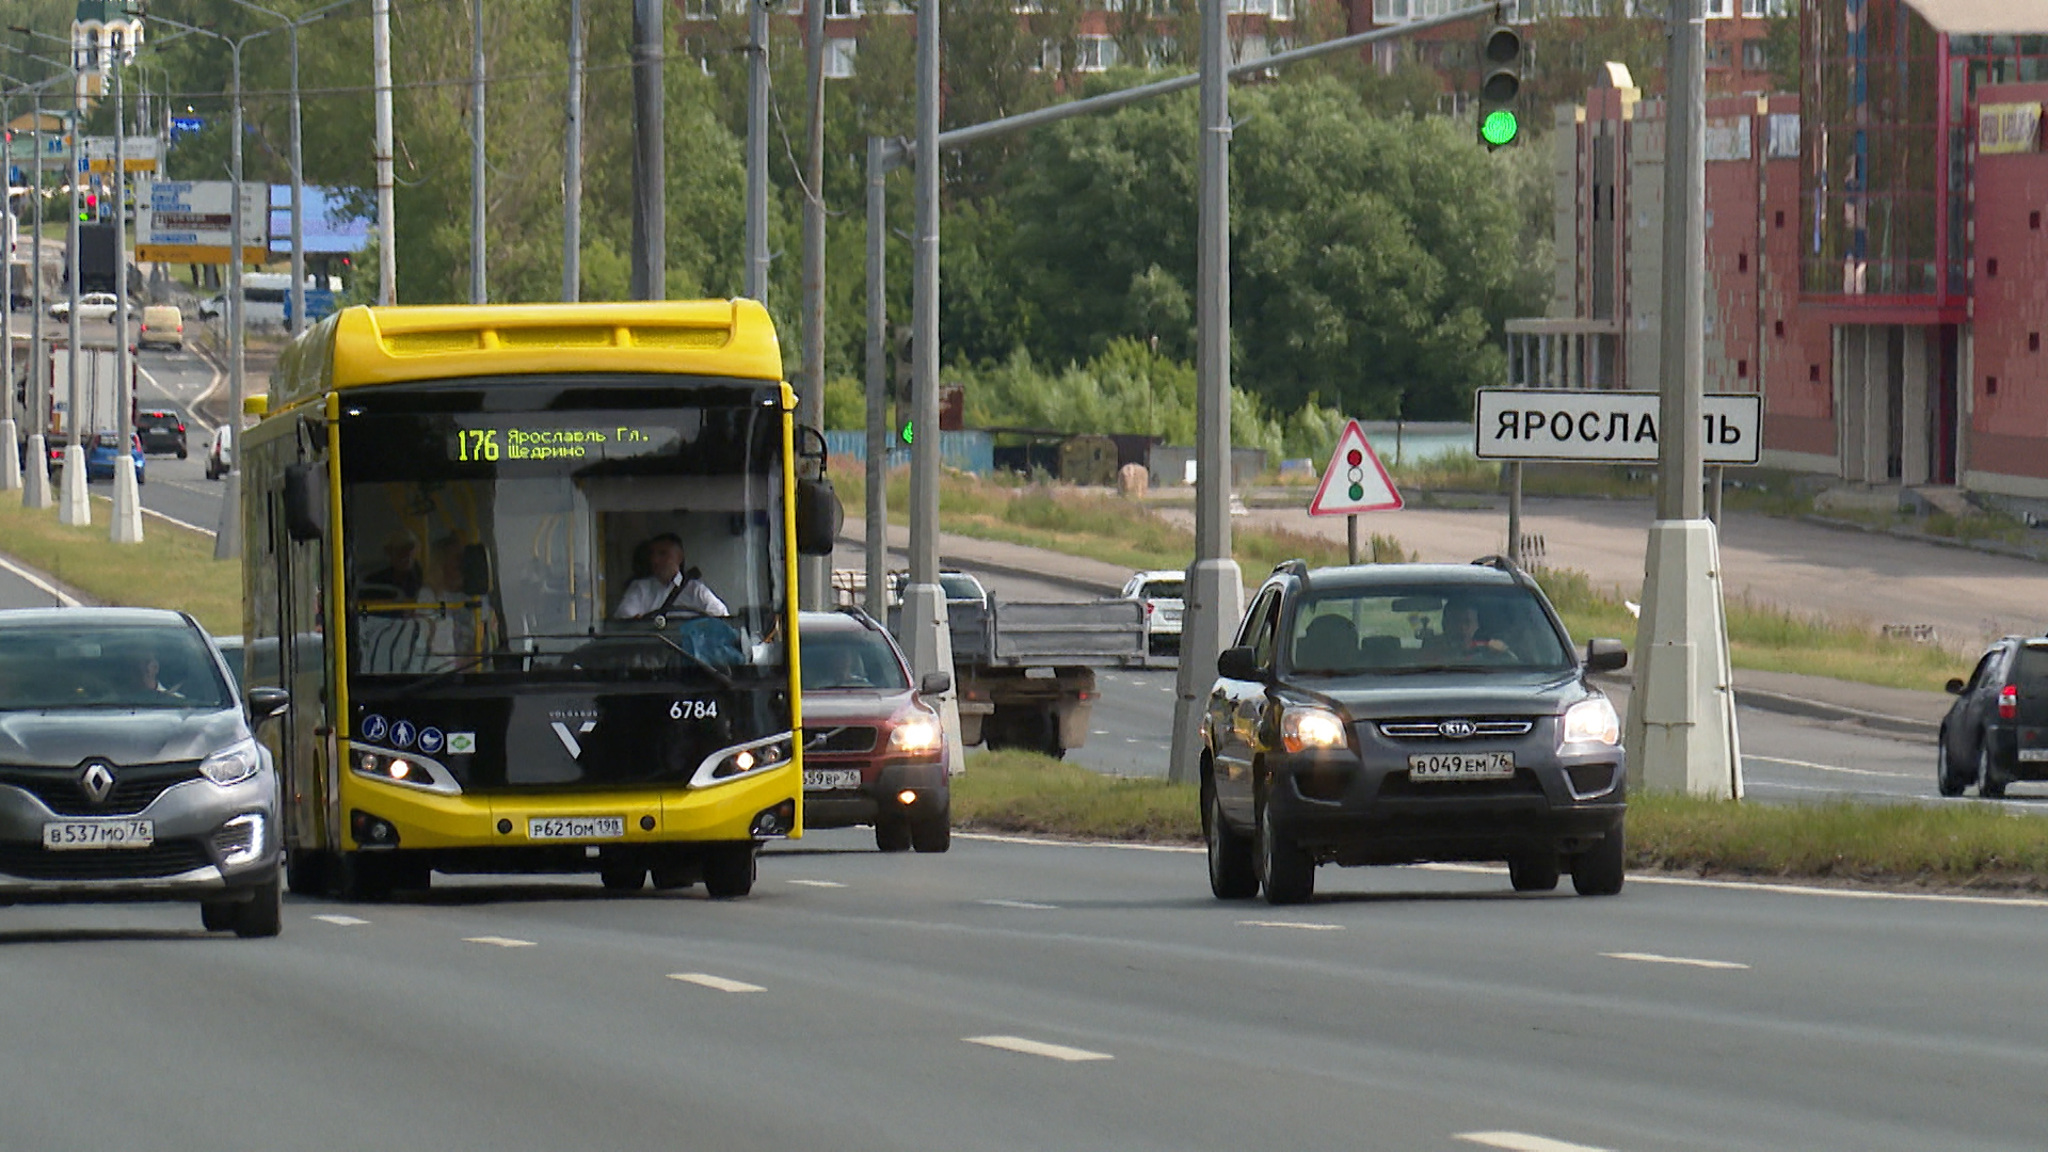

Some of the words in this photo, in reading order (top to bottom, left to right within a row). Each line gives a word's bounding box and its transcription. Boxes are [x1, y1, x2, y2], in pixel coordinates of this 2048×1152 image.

[508, 428, 606, 444] Ярославль
[617, 427, 649, 442] Гл.
[1494, 409, 1741, 445] ЯРОСЛАЬ
[458, 430, 499, 461] 176
[670, 700, 717, 719] 6784
[1445, 724, 1470, 734] KIA
